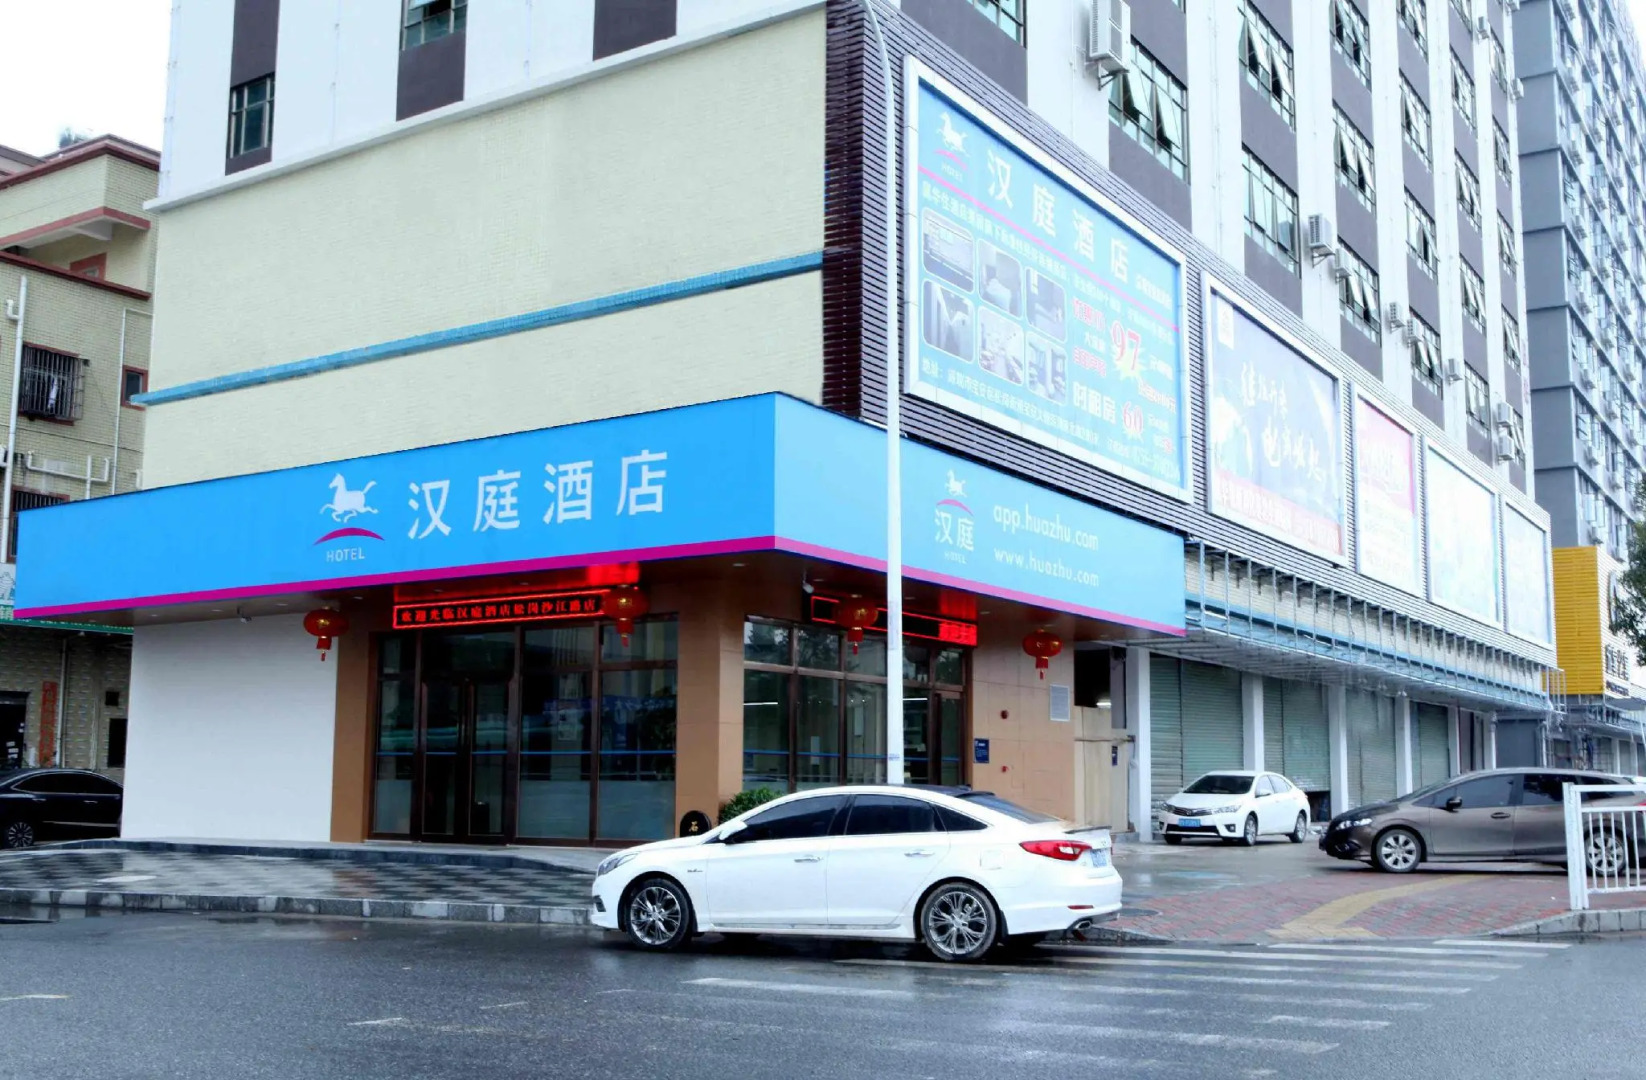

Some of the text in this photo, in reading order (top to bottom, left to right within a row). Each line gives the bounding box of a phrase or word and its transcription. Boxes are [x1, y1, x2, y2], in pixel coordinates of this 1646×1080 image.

[987, 149, 1129, 284] 汉庭酒店
[1111, 320, 1142, 372] 97
[1122, 400, 1144, 434] 60
[408, 449, 668, 540] 汉庭酒店
[934, 508, 974, 552] 汉庭
[993, 503, 1099, 550] app.huazhu.com
[326, 547, 366, 563] HOTEL
[993, 546, 1099, 587] www.huazhu.com
